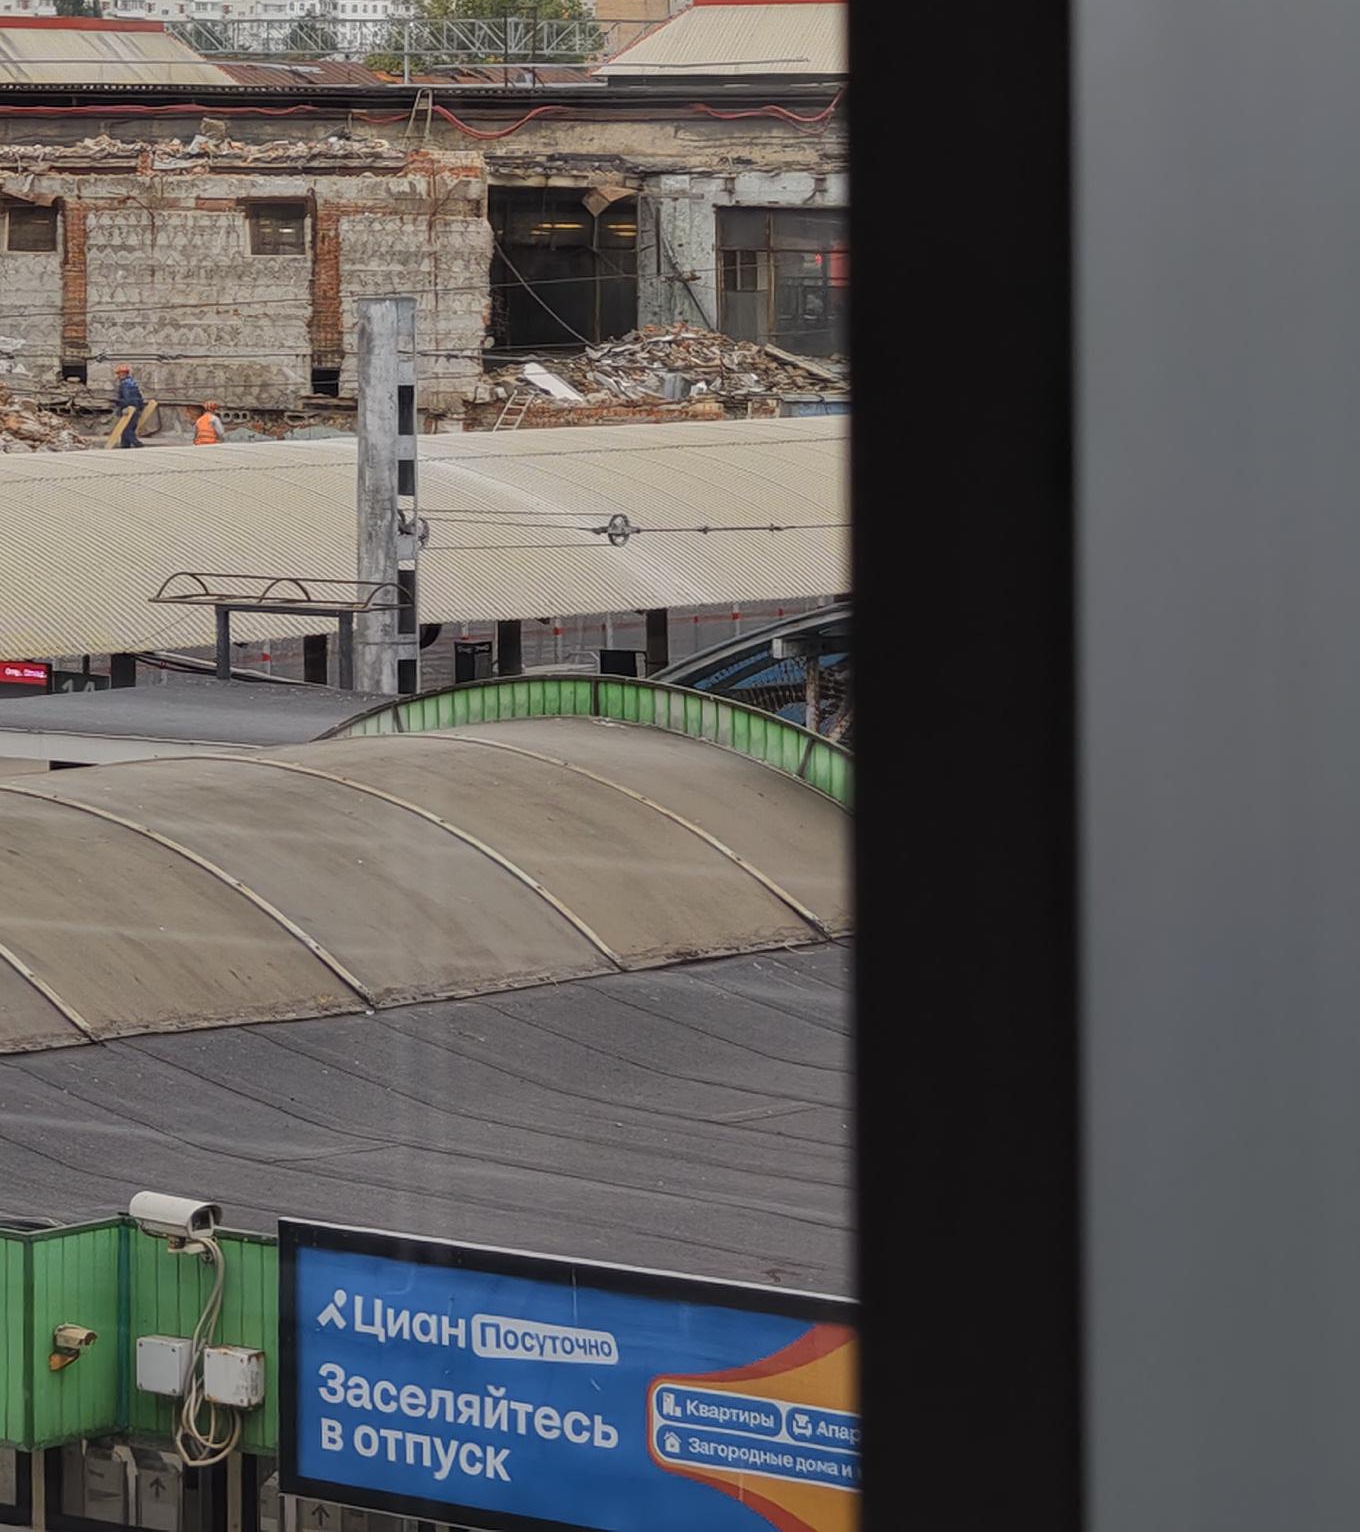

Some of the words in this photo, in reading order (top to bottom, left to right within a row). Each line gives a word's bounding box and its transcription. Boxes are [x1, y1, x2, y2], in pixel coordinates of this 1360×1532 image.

[354, 1295, 466, 1348] Циан
[481, 1322, 612, 1358] Посуточно
[318, 1362, 619, 1449] Заселяйтесь
[686, 1399, 774, 1428] Квартиры
[321, 1418, 344, 1451] в
[353, 1424, 512, 1482] отпуск
[688, 1437, 793, 1468] Загородные
[795, 1457, 838, 1475] дома
[840, 1464, 853, 1478] и
